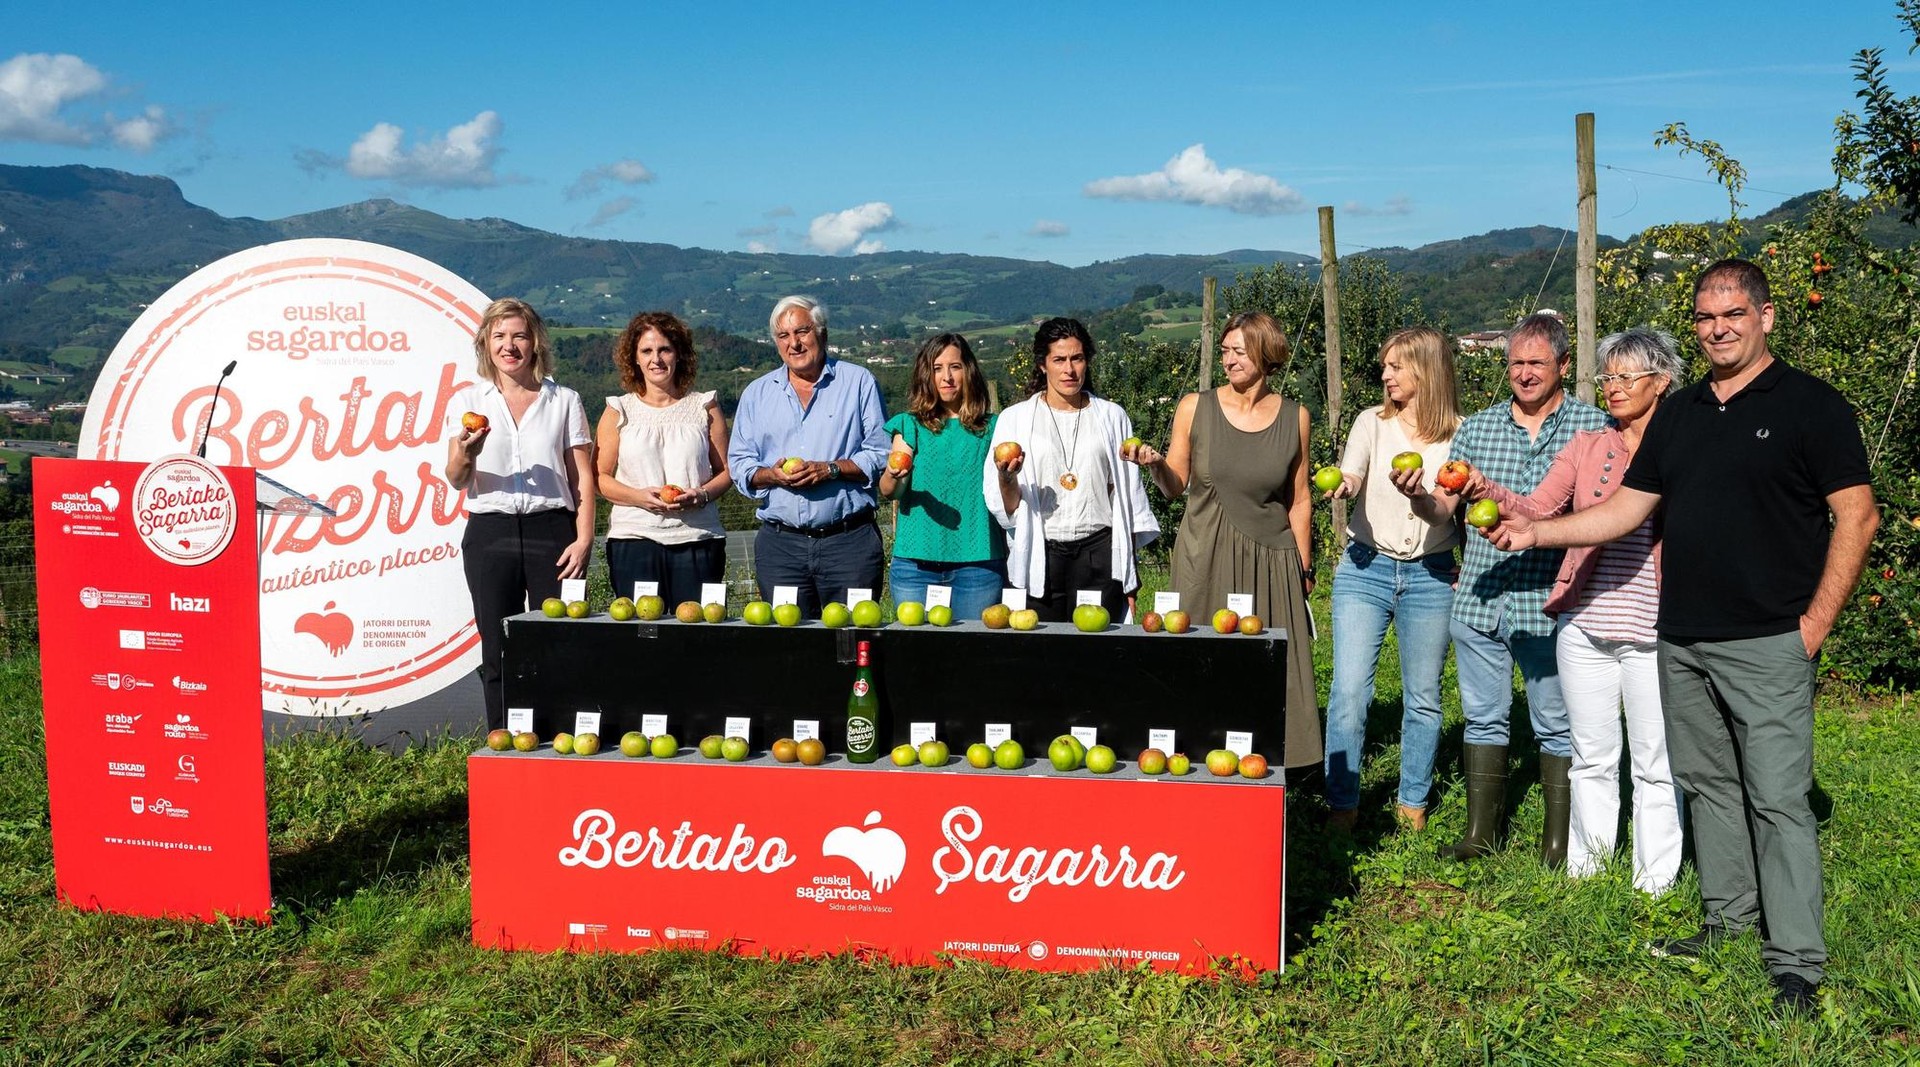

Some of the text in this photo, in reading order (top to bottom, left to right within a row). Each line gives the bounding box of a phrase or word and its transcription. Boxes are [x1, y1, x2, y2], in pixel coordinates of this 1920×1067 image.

[283, 301, 366, 323] euskal
[247, 325, 411, 360] sagardoa
[371, 357, 395, 366] Vasco
[61, 492, 88, 502] euskal
[149, 484, 229, 510] Bertako
[51, 501, 103, 514] sagardoa
[139, 506, 224, 537] Sagarra
[261, 542, 460, 594] auténtico placer
[170, 592, 210, 612] hazi
[362, 619, 431, 629] JATORRI DEITURA
[362, 630, 427, 639] DENOMINACIÓN
[362, 639, 406, 648] DE ORIGEN
[105, 713, 133, 724] araba
[108, 762, 145, 773] EUSKADI
[104, 836, 213, 852] www.euskalsagardoa.eus
[558, 808, 797, 874] Bertako
[932, 805, 1186, 903] Sagarra
[812, 875, 851, 886] euskal
[796, 886, 872, 903] sagardoa
[829, 902, 893, 913] Sidra del País Vasco
[943, 941, 1021, 953] JATORRI DEITURA
[1056, 946, 1180, 961] DENOMINACIÓN DE ORIGEN
